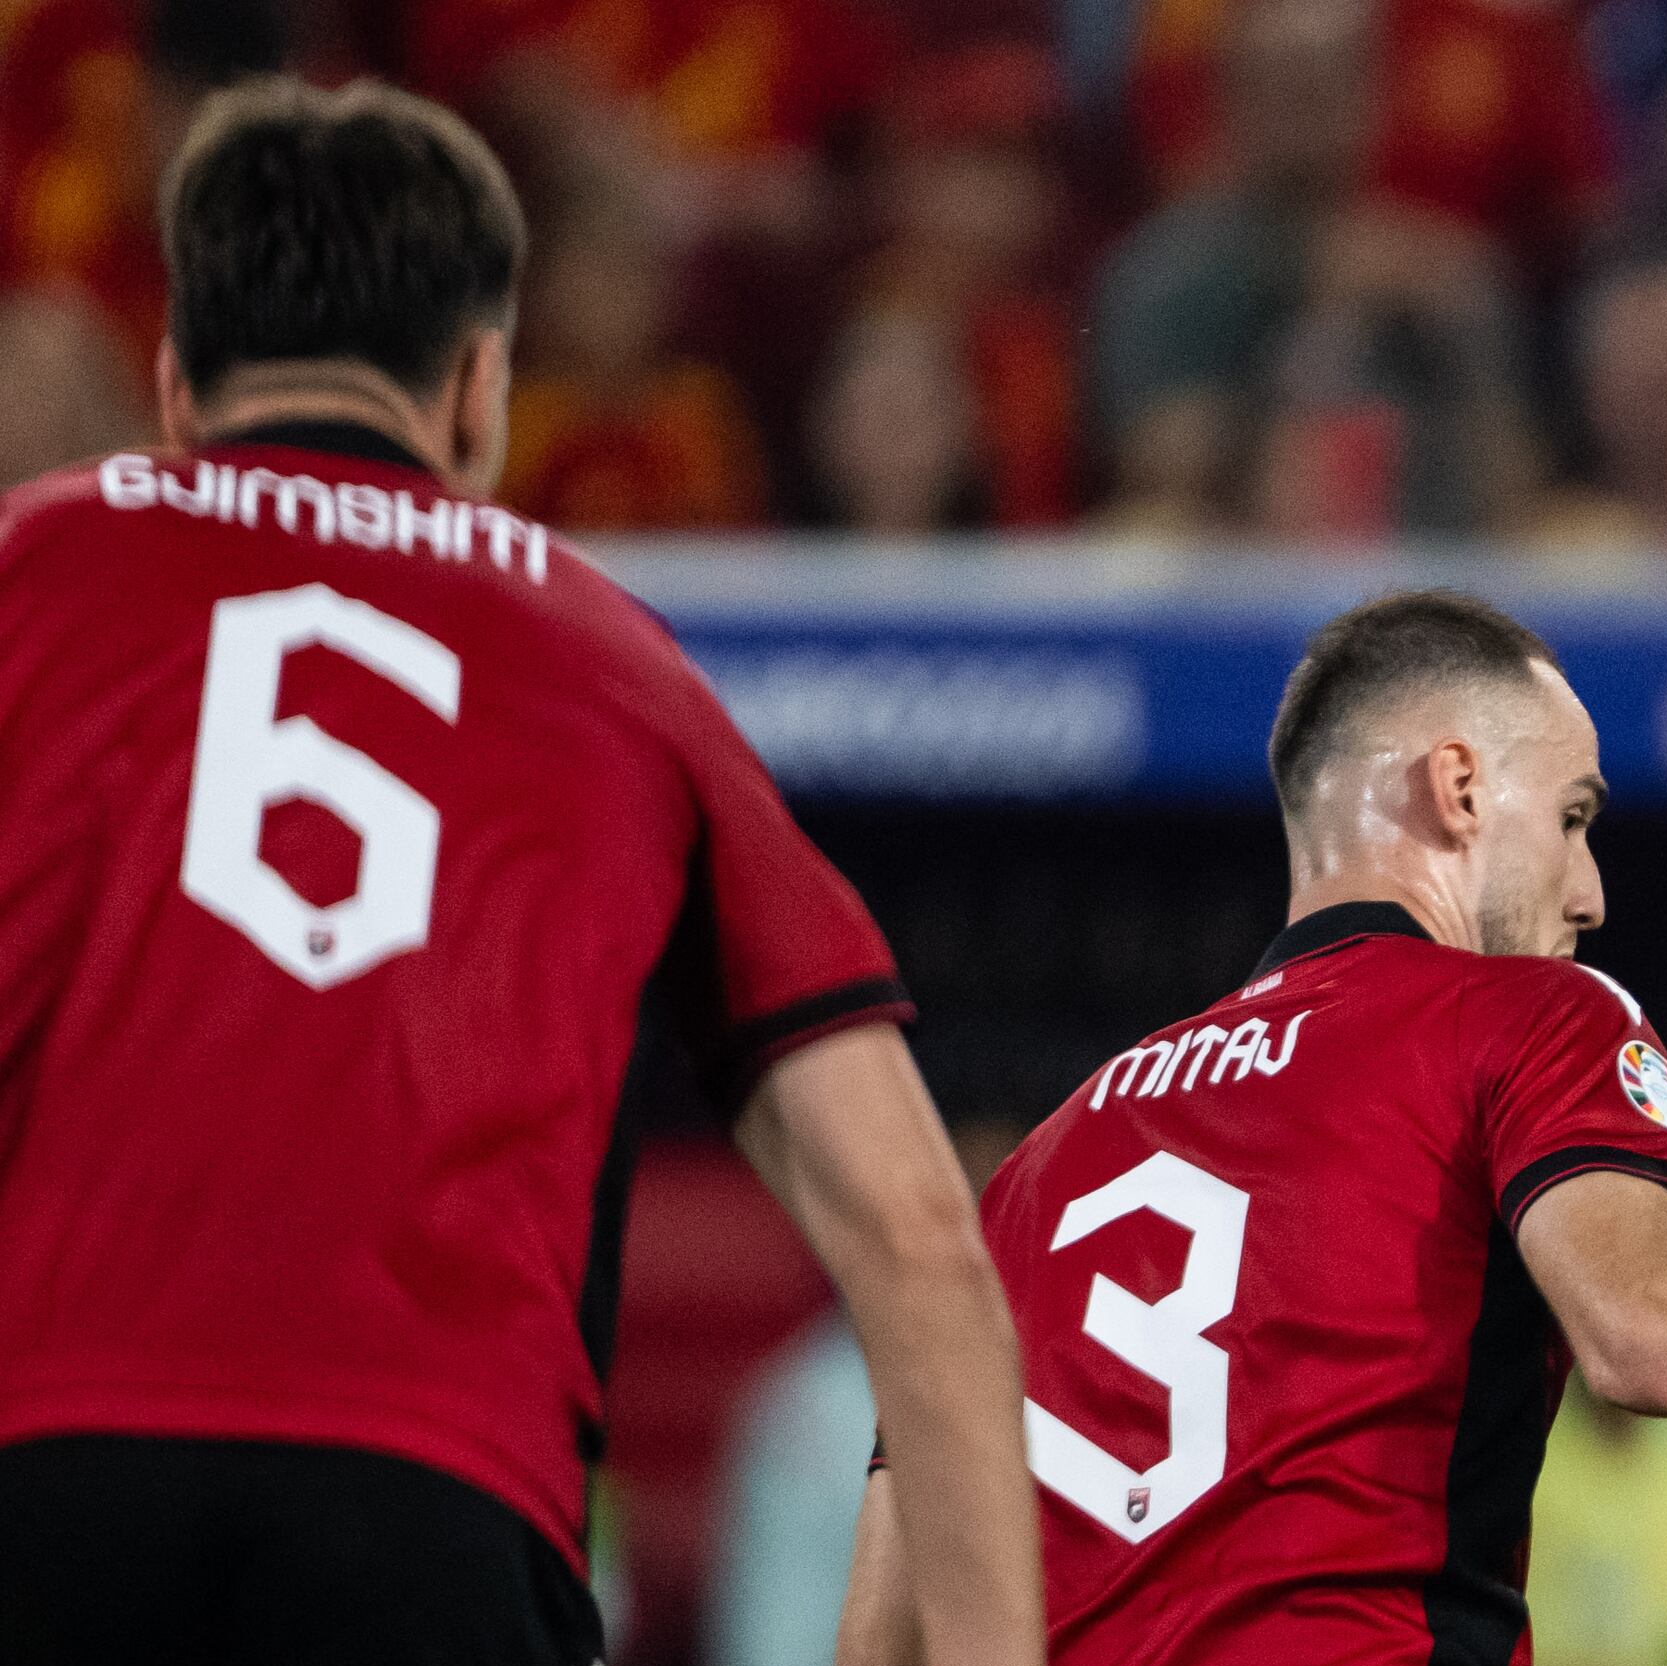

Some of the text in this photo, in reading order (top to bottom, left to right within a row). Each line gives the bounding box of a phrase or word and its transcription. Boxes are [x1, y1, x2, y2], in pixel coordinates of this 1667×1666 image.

[180, 581, 462, 992] 6
[1090, 1010, 1312, 1112] MITAJ
[1023, 1150, 1250, 1545] 3
